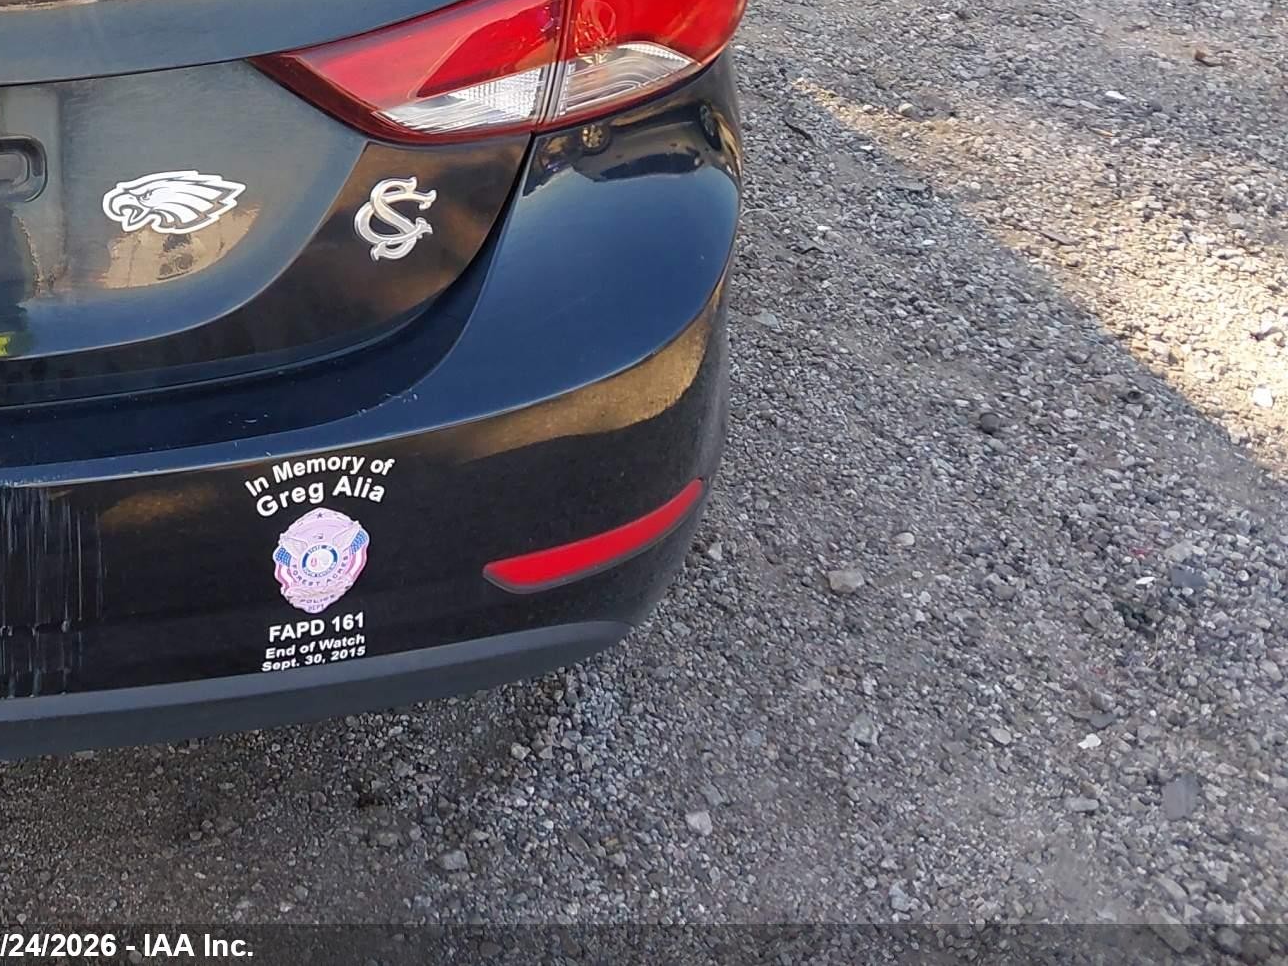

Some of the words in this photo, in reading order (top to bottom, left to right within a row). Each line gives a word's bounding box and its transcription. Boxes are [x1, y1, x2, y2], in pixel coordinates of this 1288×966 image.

[244, 476, 269, 497] In
[272, 456, 365, 484] Memory
[370, 458, 394, 475] of
[256, 482, 324, 517] Greg
[332, 475, 386, 503] Alia
[269, 619, 325, 643] FAPD
[332, 612, 364, 633] 161
[261, 658, 300, 672] Sept.
[304, 653, 326, 665] 30,
[330, 646, 366, 661] 2015
[265, 645, 296, 660] End
[299, 641, 316, 654] of
[318, 633, 365, 651] Watch
